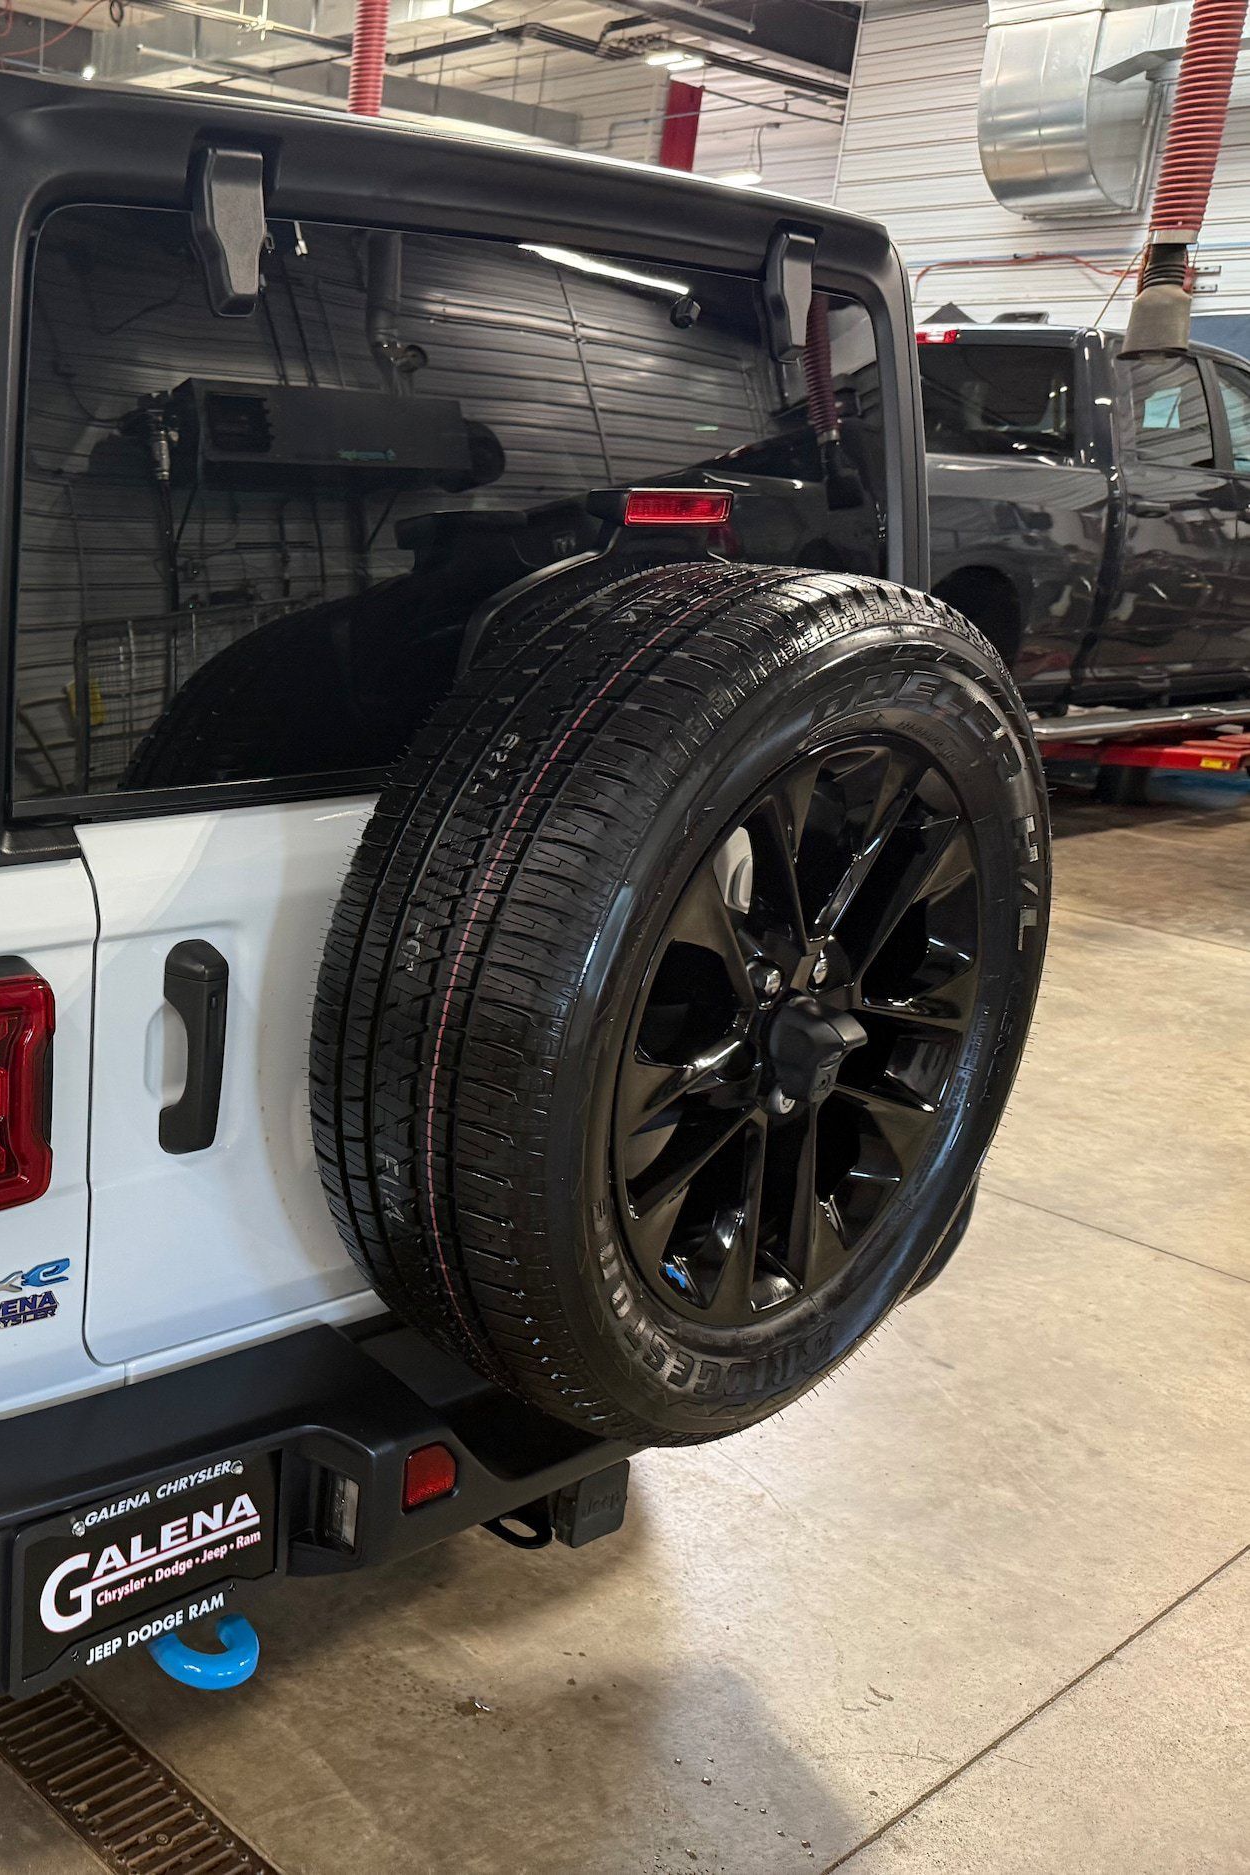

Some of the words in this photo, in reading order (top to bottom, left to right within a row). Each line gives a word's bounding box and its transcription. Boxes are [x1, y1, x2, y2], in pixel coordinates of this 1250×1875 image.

[84, 1490, 151, 1528] GALENA
[156, 1460, 232, 1501] CHRYSLER
[39, 1492, 261, 1634] GALENA
[96, 1577, 147, 1607] Chrysler
[155, 1558, 193, 1584] Dodge
[201, 1543, 228, 1564] Jeep
[236, 1530, 261, 1550] Ram
[86, 1636, 122, 1666] JEEP
[127, 1609, 184, 1648] DODGE
[189, 1592, 225, 1620] RAM
